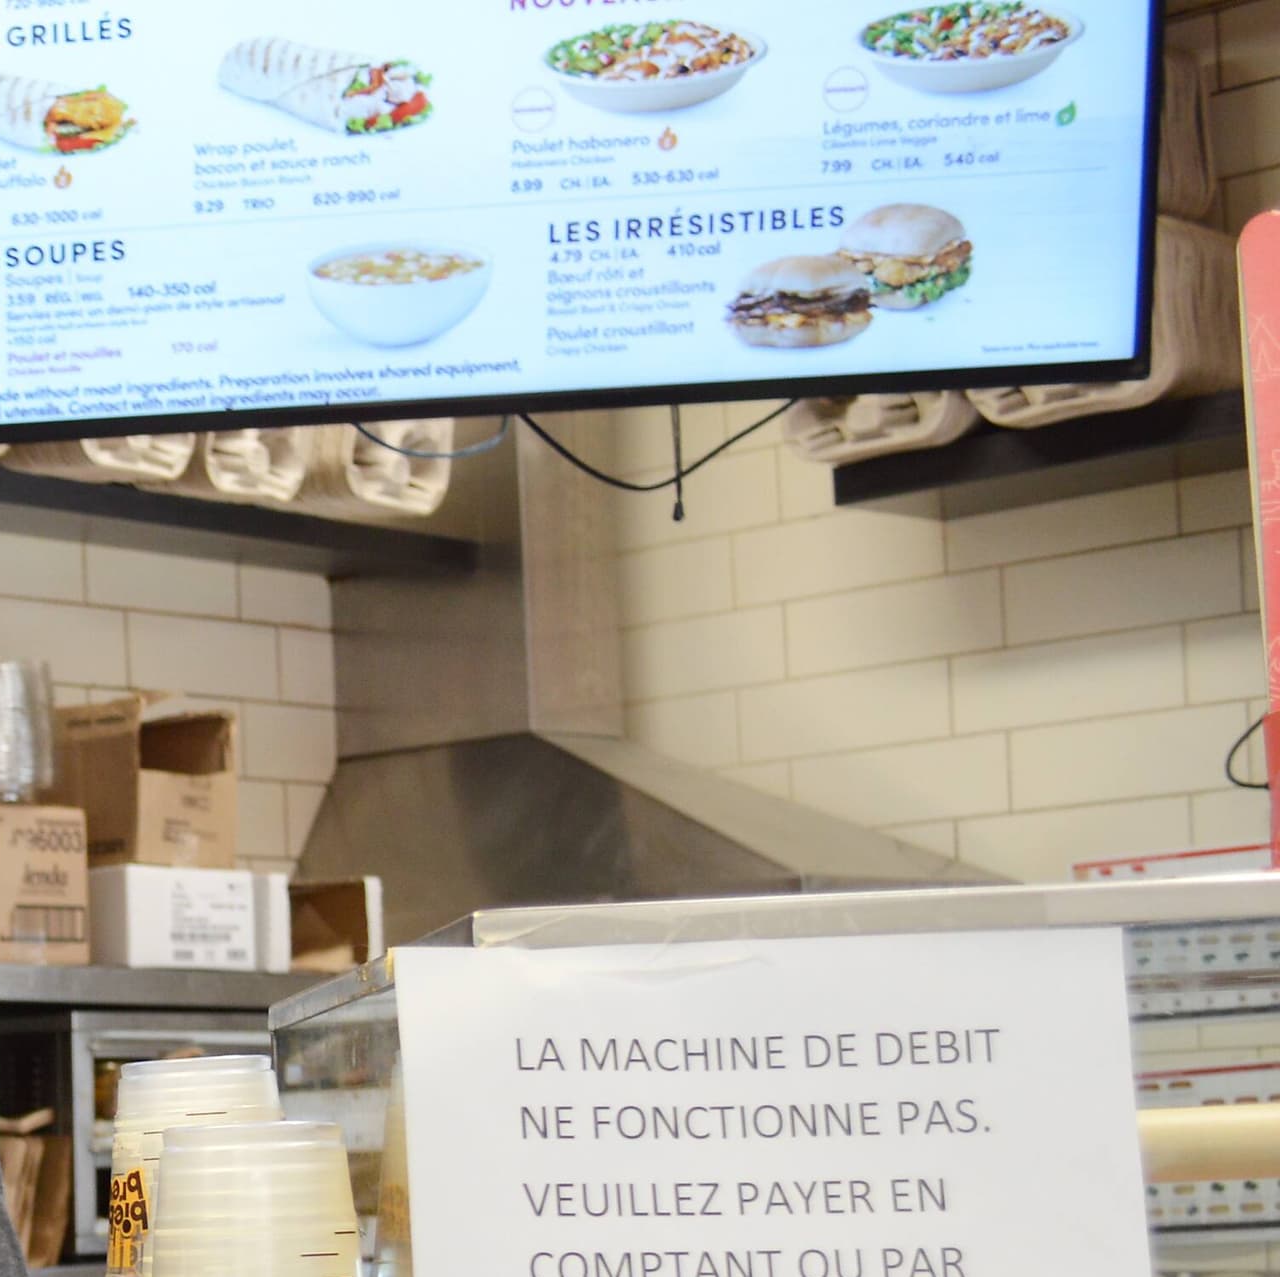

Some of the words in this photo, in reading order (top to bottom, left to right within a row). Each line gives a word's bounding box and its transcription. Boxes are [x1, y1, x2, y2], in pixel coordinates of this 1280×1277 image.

[6, 11, 132, 47] GRILLÉS
[907, 112, 989, 130] coriandre
[994, 111, 1011, 125] et
[1015, 108, 1051, 123] lime
[548, 220, 600, 244] LES
[614, 206, 846, 241] IRRÉSISTIBLES
[4, 240, 126, 268] SOUPES
[515, 1036, 565, 1072] LA
[580, 1034, 787, 1072] MACHINE
[802, 1032, 859, 1069] DE
[875, 1028, 1000, 1066] DEBIT
[519, 1105, 576, 1140] NE
[591, 1101, 882, 1140] FONCTIONNE
[897, 1098, 992, 1136] PAS.
[523, 1181, 723, 1217] VEUILLEZ
[736, 1179, 876, 1216] PAYER
[891, 1177, 949, 1213] EN
